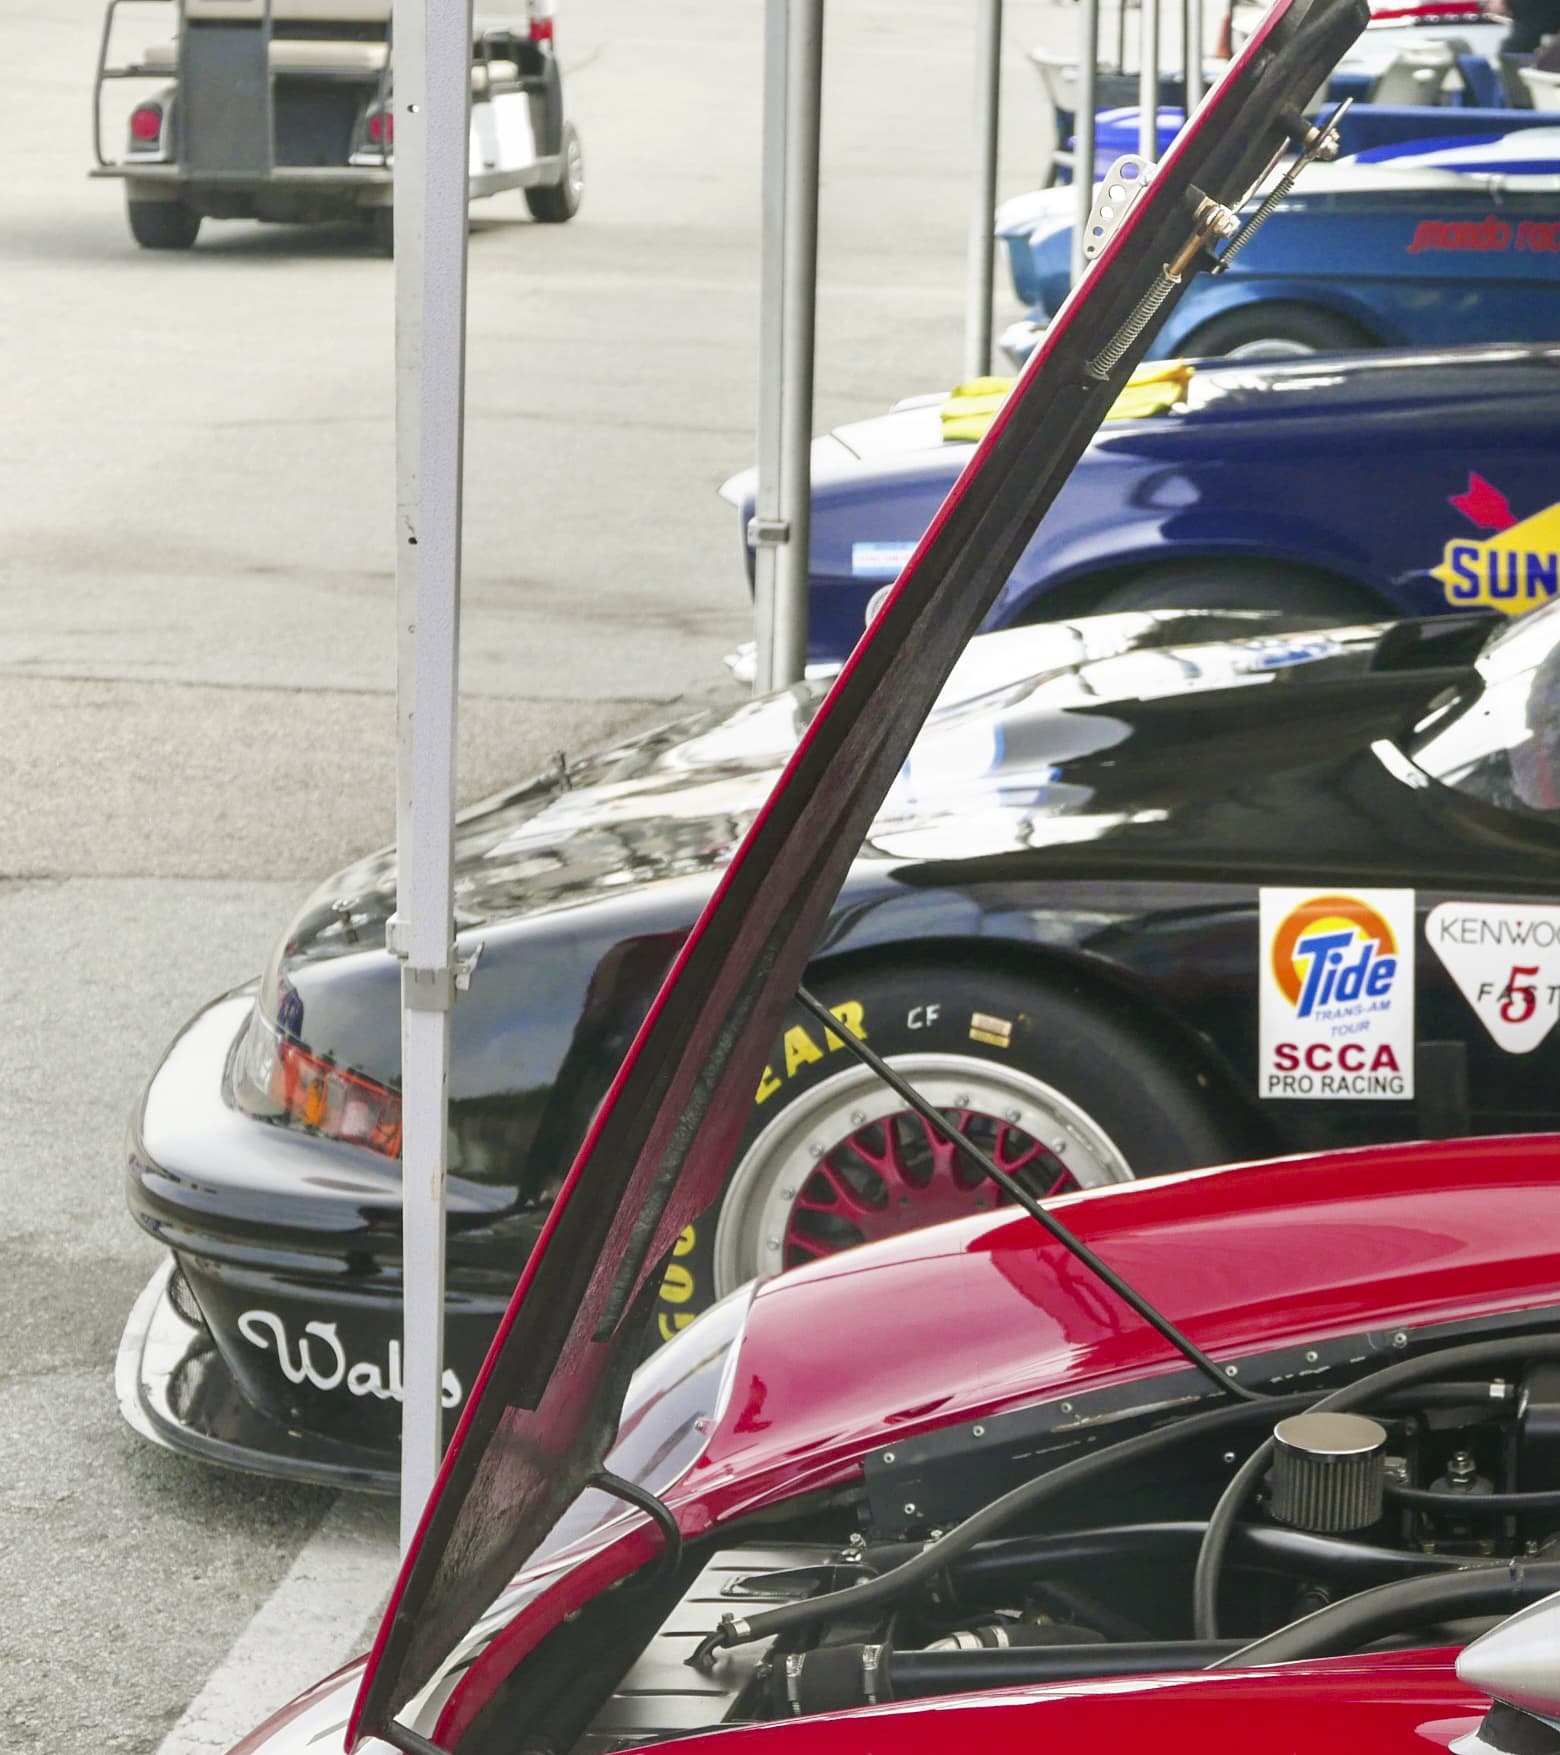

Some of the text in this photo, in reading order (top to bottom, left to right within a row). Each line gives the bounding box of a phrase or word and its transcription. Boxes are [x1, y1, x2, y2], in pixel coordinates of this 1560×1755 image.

[1297, 930, 1398, 1019] Tide
[1500, 966, 1540, 1023] 5
[907, 1004, 941, 1030] CF
[1313, 1000, 1393, 1022] TRANS-AM
[1330, 1020, 1370, 1038] TOUR
[1273, 1043, 1399, 1072] SCCA
[1268, 1075, 1405, 1096] PRO RACING
